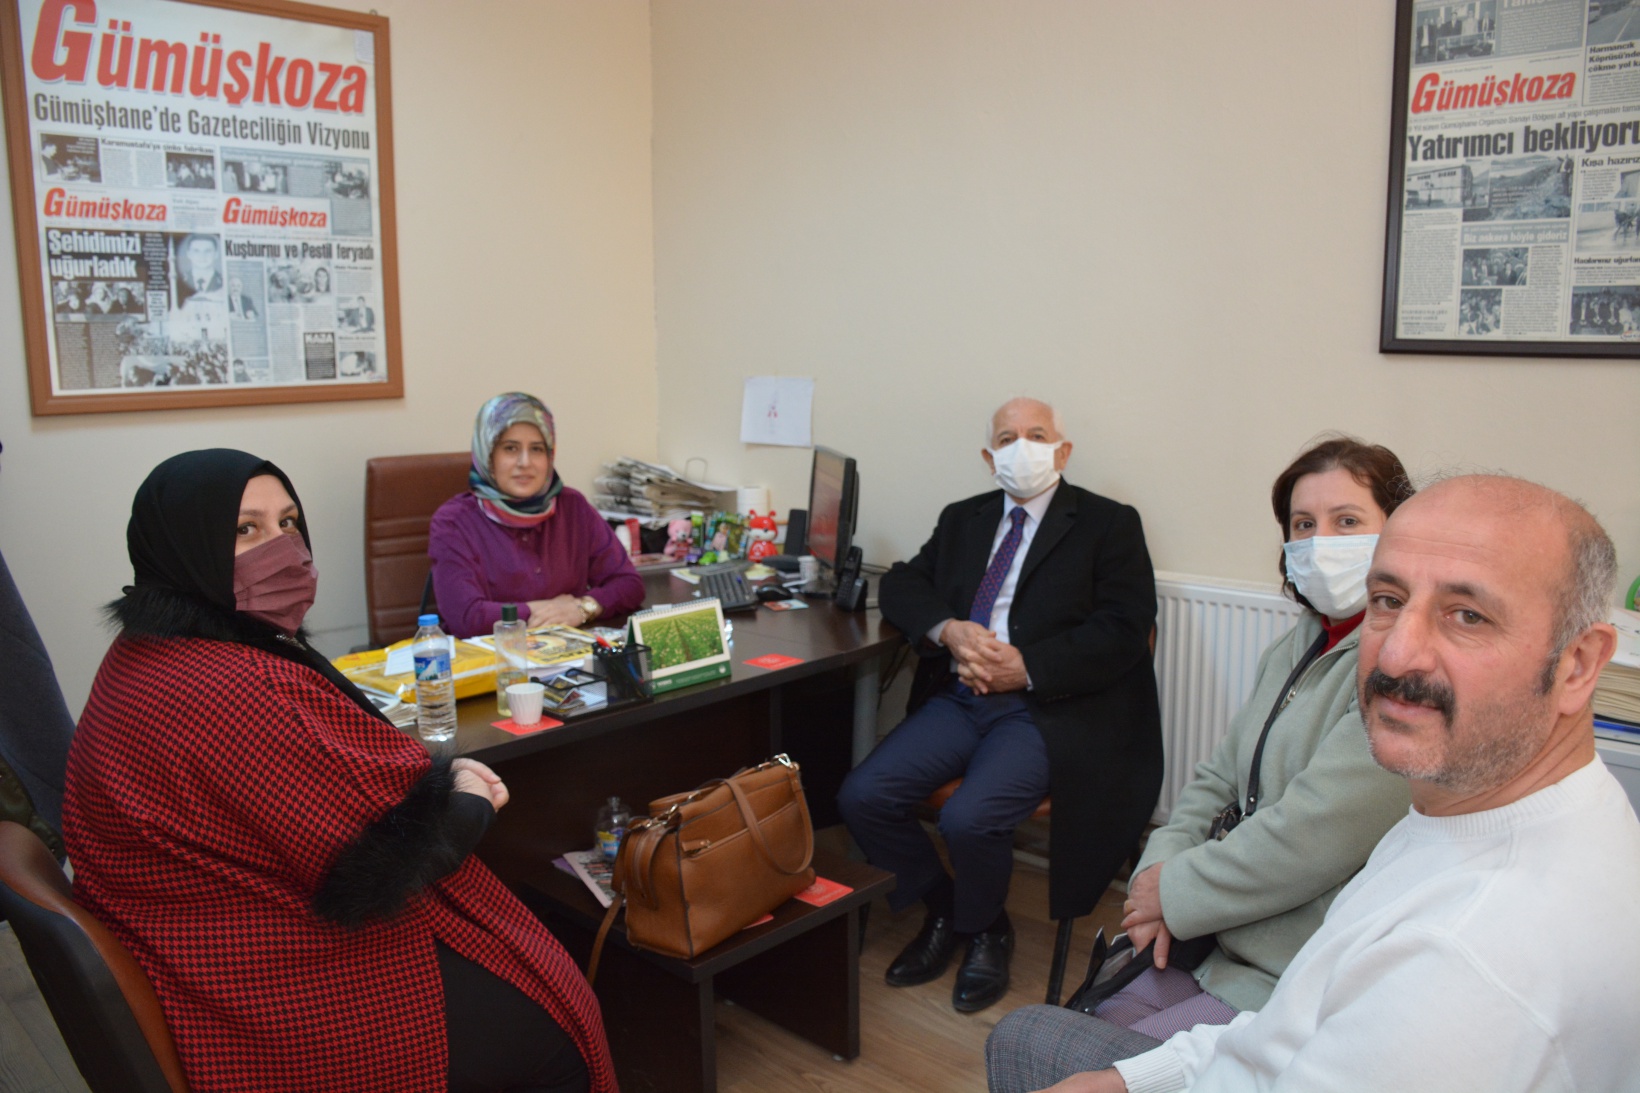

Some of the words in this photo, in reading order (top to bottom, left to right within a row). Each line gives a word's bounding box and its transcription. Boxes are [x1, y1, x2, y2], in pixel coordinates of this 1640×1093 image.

[31, 0, 368, 116] Gümüşkoza
[1618, 60, 1631, 70] yol
[1411, 72, 1576, 114] Gümüşkoza
[34, 92, 181, 134] Gümüşhane'de
[188, 110, 302, 146] Gazeteciliğin
[307, 121, 370, 150] Vizyonu
[1408, 131, 1514, 162] Yatırımcı
[43, 187, 168, 221] Gümüşkoza
[222, 197, 328, 228] Gümüşkoza
[48, 229, 141, 256] Şehidimizi
[225, 240, 280, 260] Kuşburnu
[285, 244, 298, 258] ve
[302, 242, 332, 259] Pestil
[336, 244, 374, 262] feryadı
[51, 255, 137, 281] uğurladık
